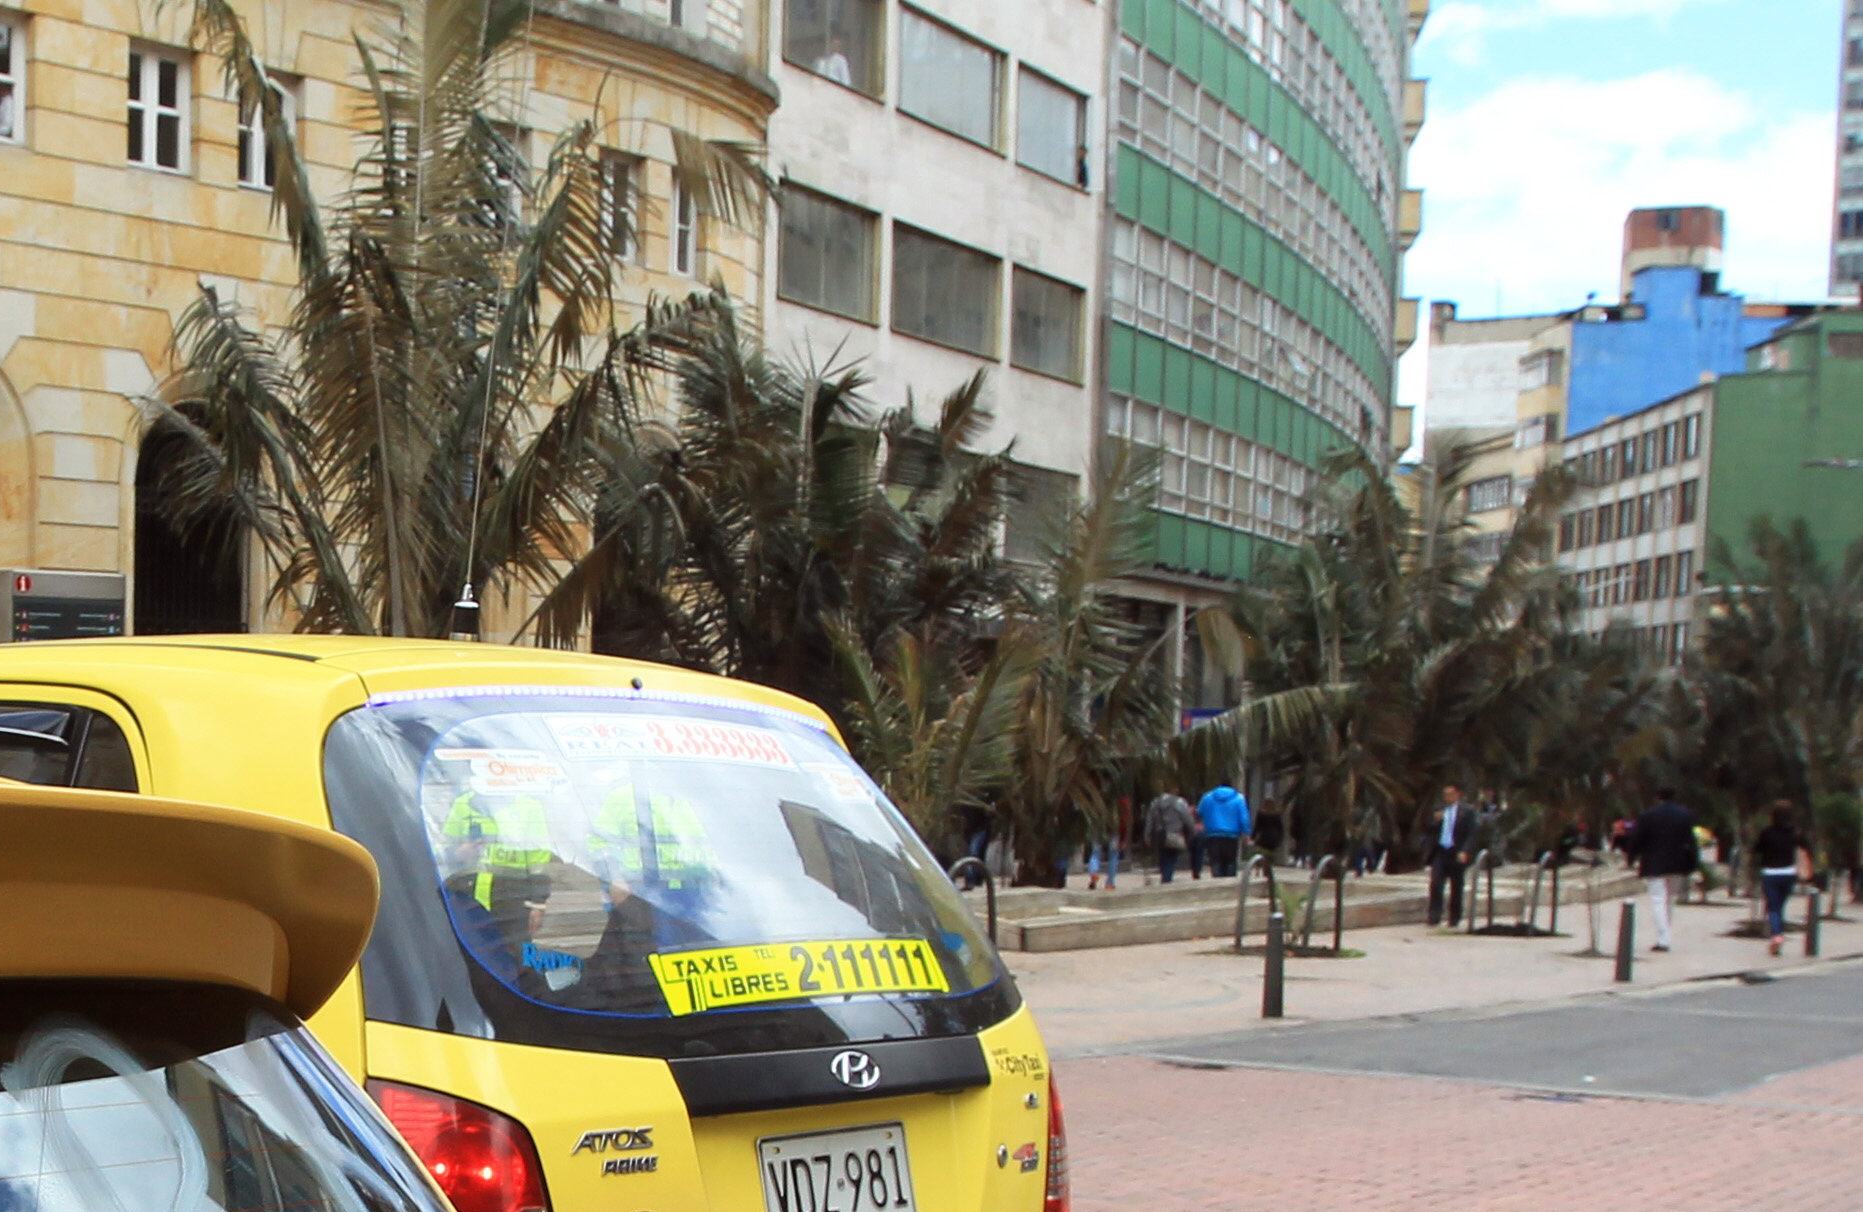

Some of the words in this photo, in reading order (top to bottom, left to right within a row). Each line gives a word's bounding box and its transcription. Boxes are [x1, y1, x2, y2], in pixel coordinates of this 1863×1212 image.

[673, 953, 736, 977] TAXIS
[711, 972, 789, 999] LIBRES
[571, 1125, 654, 1155] ATOS
